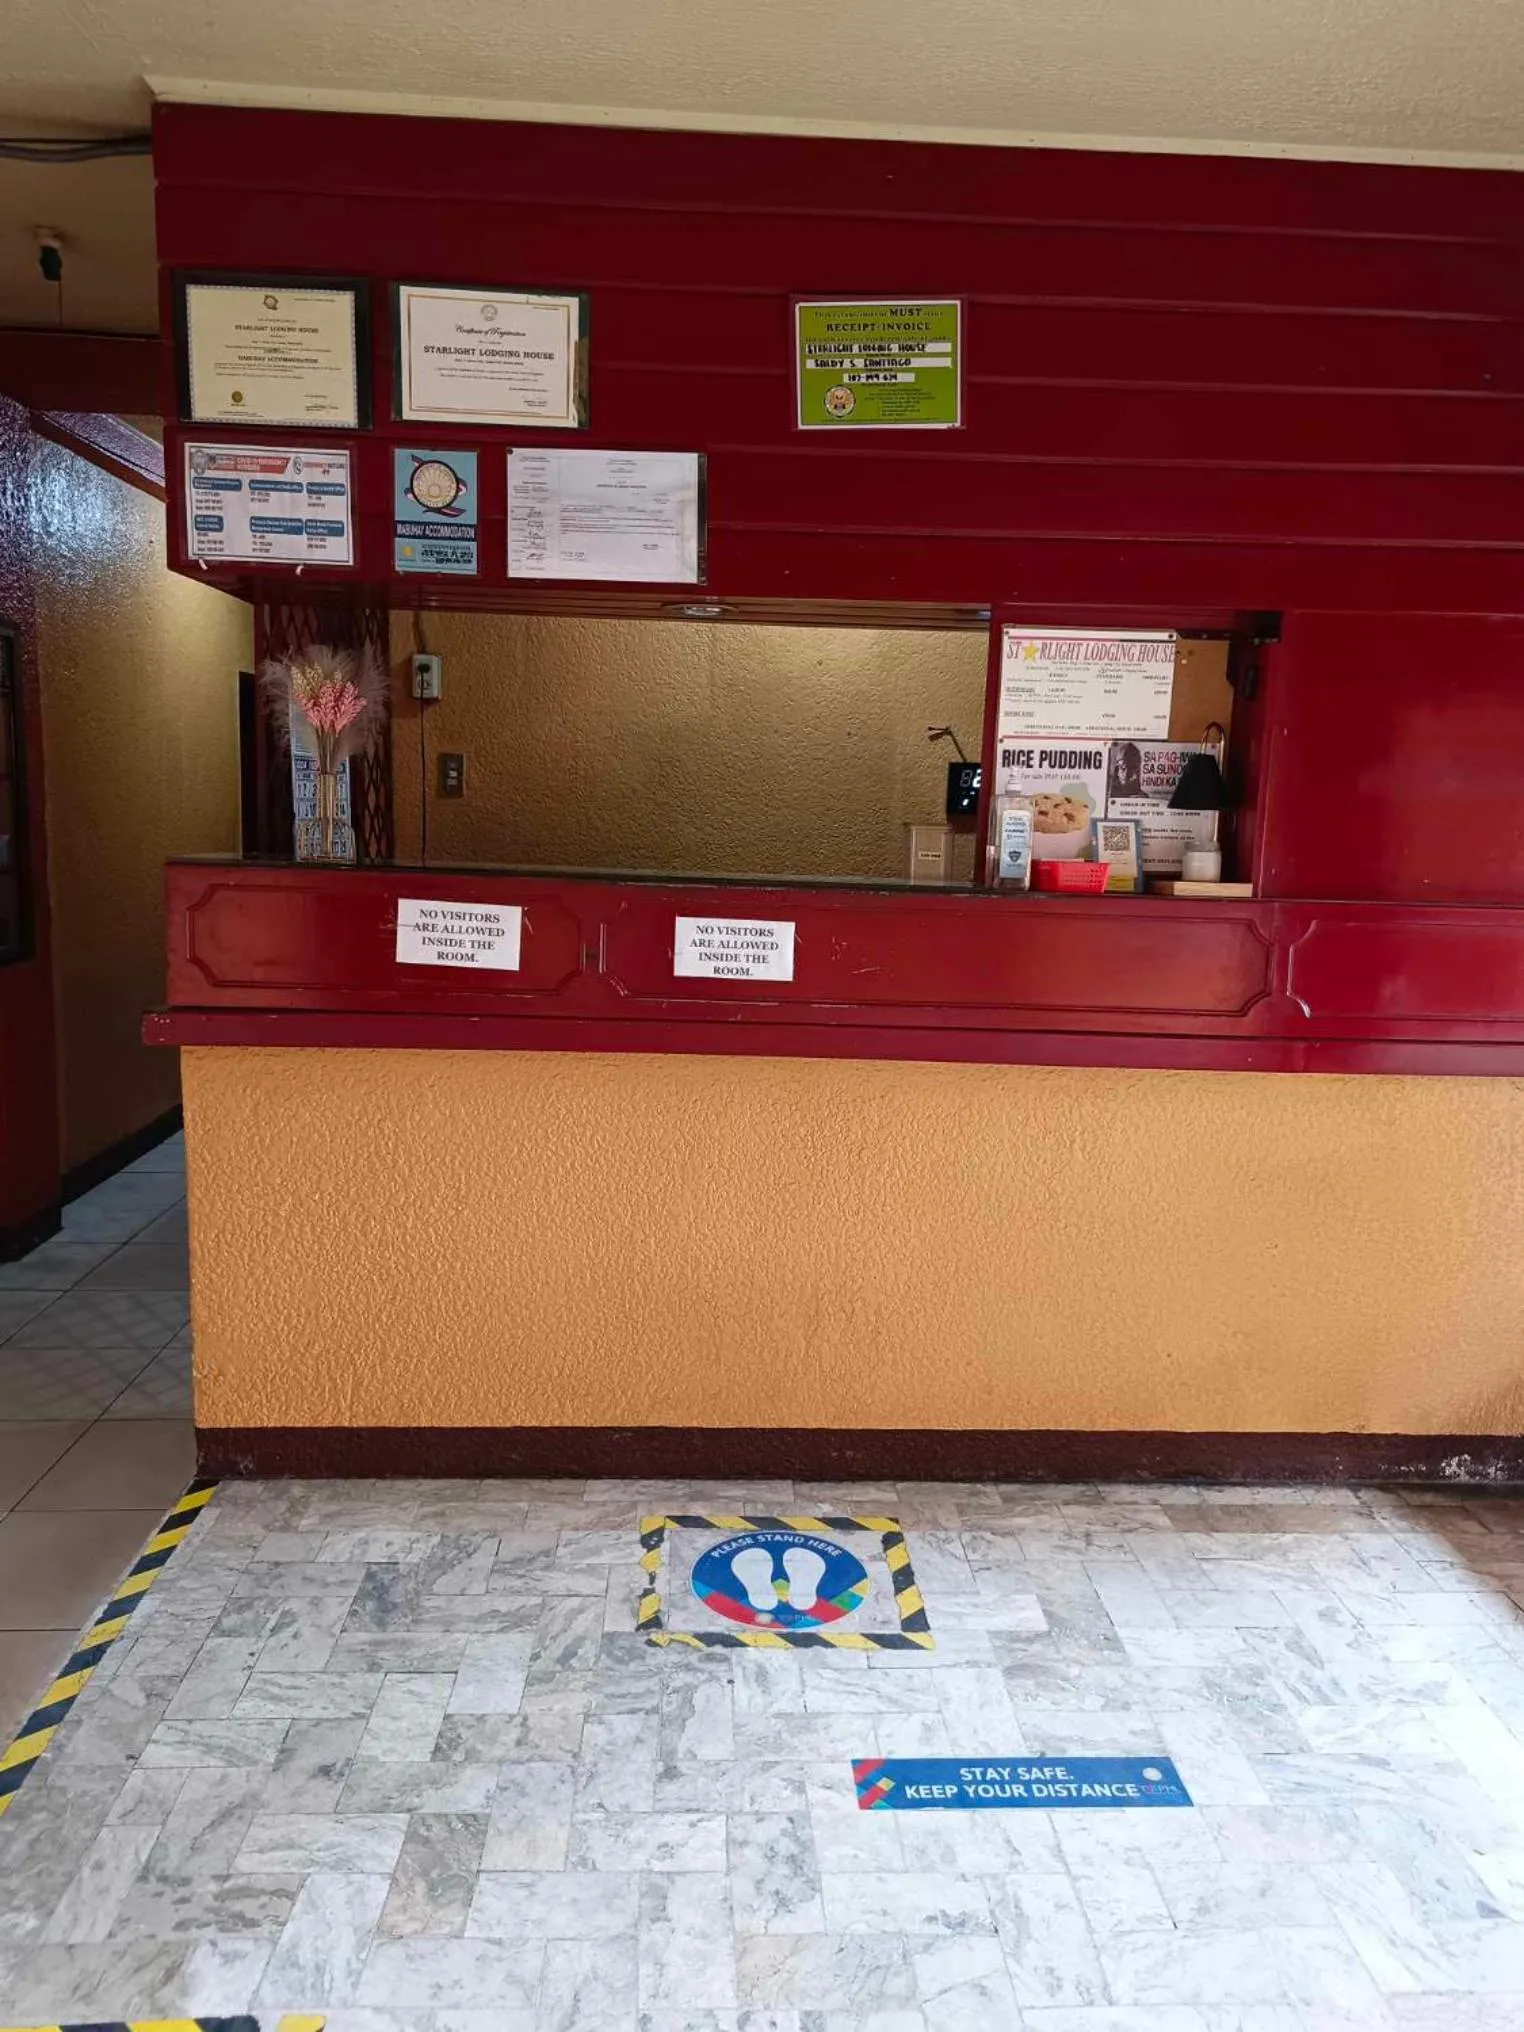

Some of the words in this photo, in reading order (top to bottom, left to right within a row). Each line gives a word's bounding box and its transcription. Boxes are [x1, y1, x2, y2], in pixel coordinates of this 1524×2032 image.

[889, 308, 922, 317] MUST
[424, 345, 476, 356] STARLIGHT
[479, 348, 520, 358] LODGING
[523, 351, 555, 360] HOUSE
[396, 523, 424, 536] MABUHAY
[426, 525, 474, 538] ACCOMMODATION
[1084, 643, 1136, 662] LODGING
[1002, 749, 1034, 768] RICE
[1039, 750, 1102, 770] PUDDING
[420, 908, 438, 920] NO
[440, 910, 500, 923] VISITORS
[412, 922, 439, 933] ARE
[440, 924, 506, 938] ALLOWED
[695, 924, 714, 936] NO
[717, 925, 774, 938] VISITORS
[421, 936, 467, 949] INSIDE
[469, 939, 496, 950] THE
[689, 938, 716, 950] ARE
[718, 940, 780, 952] ALLOWED
[436, 950, 479, 963] ROOM.
[698, 952, 741, 964] INSIDE
[743, 953, 770, 964] THE
[712, 964, 754, 977] ROOM.
[711, 1534, 755, 1558] PLEASE
[756, 1534, 805, 1544] STAND
[807, 1537, 842, 1558] HERE
[960, 1767, 1014, 1781] STAY
[1019, 1767, 1074, 1781] SAFE.
[905, 1784, 958, 1798] KEEP
[964, 1784, 1030, 1798] YOUR
[1034, 1783, 1140, 1798] DISTANCE
